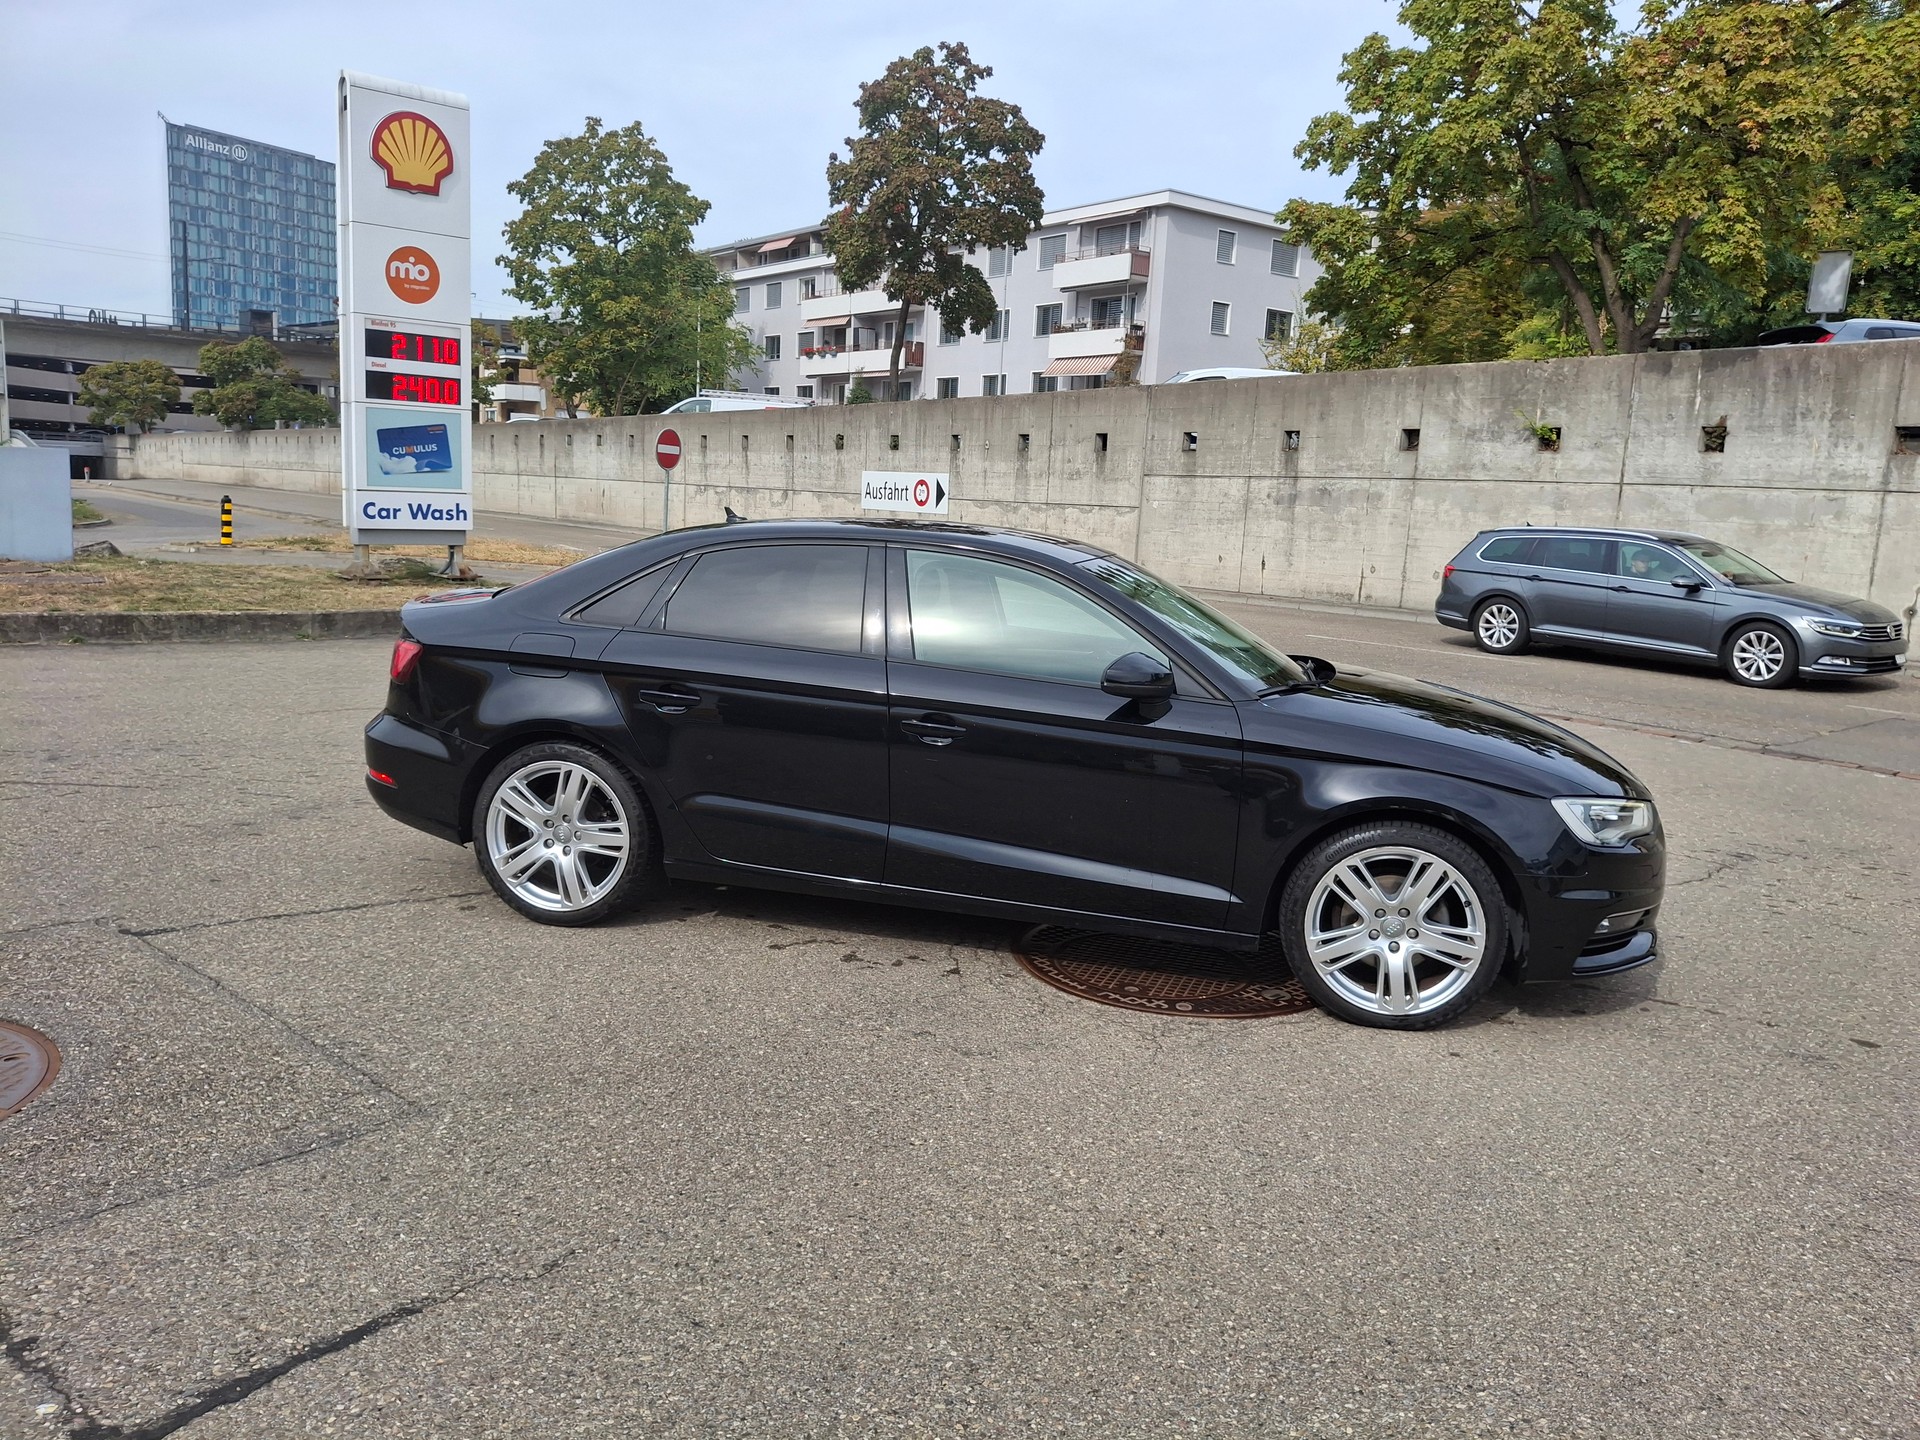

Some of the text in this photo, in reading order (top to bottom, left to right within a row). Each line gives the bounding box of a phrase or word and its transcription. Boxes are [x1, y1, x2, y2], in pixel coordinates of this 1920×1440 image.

[184, 134, 230, 155] Allianz
[390, 256, 430, 282] mio
[392, 374, 459, 405] 240.0
[392, 443, 438, 455] CUMULUS
[864, 481, 909, 502] Ausfahrt
[362, 501, 468, 521] Car Wash
[1325, 833, 1377, 862] Continental
